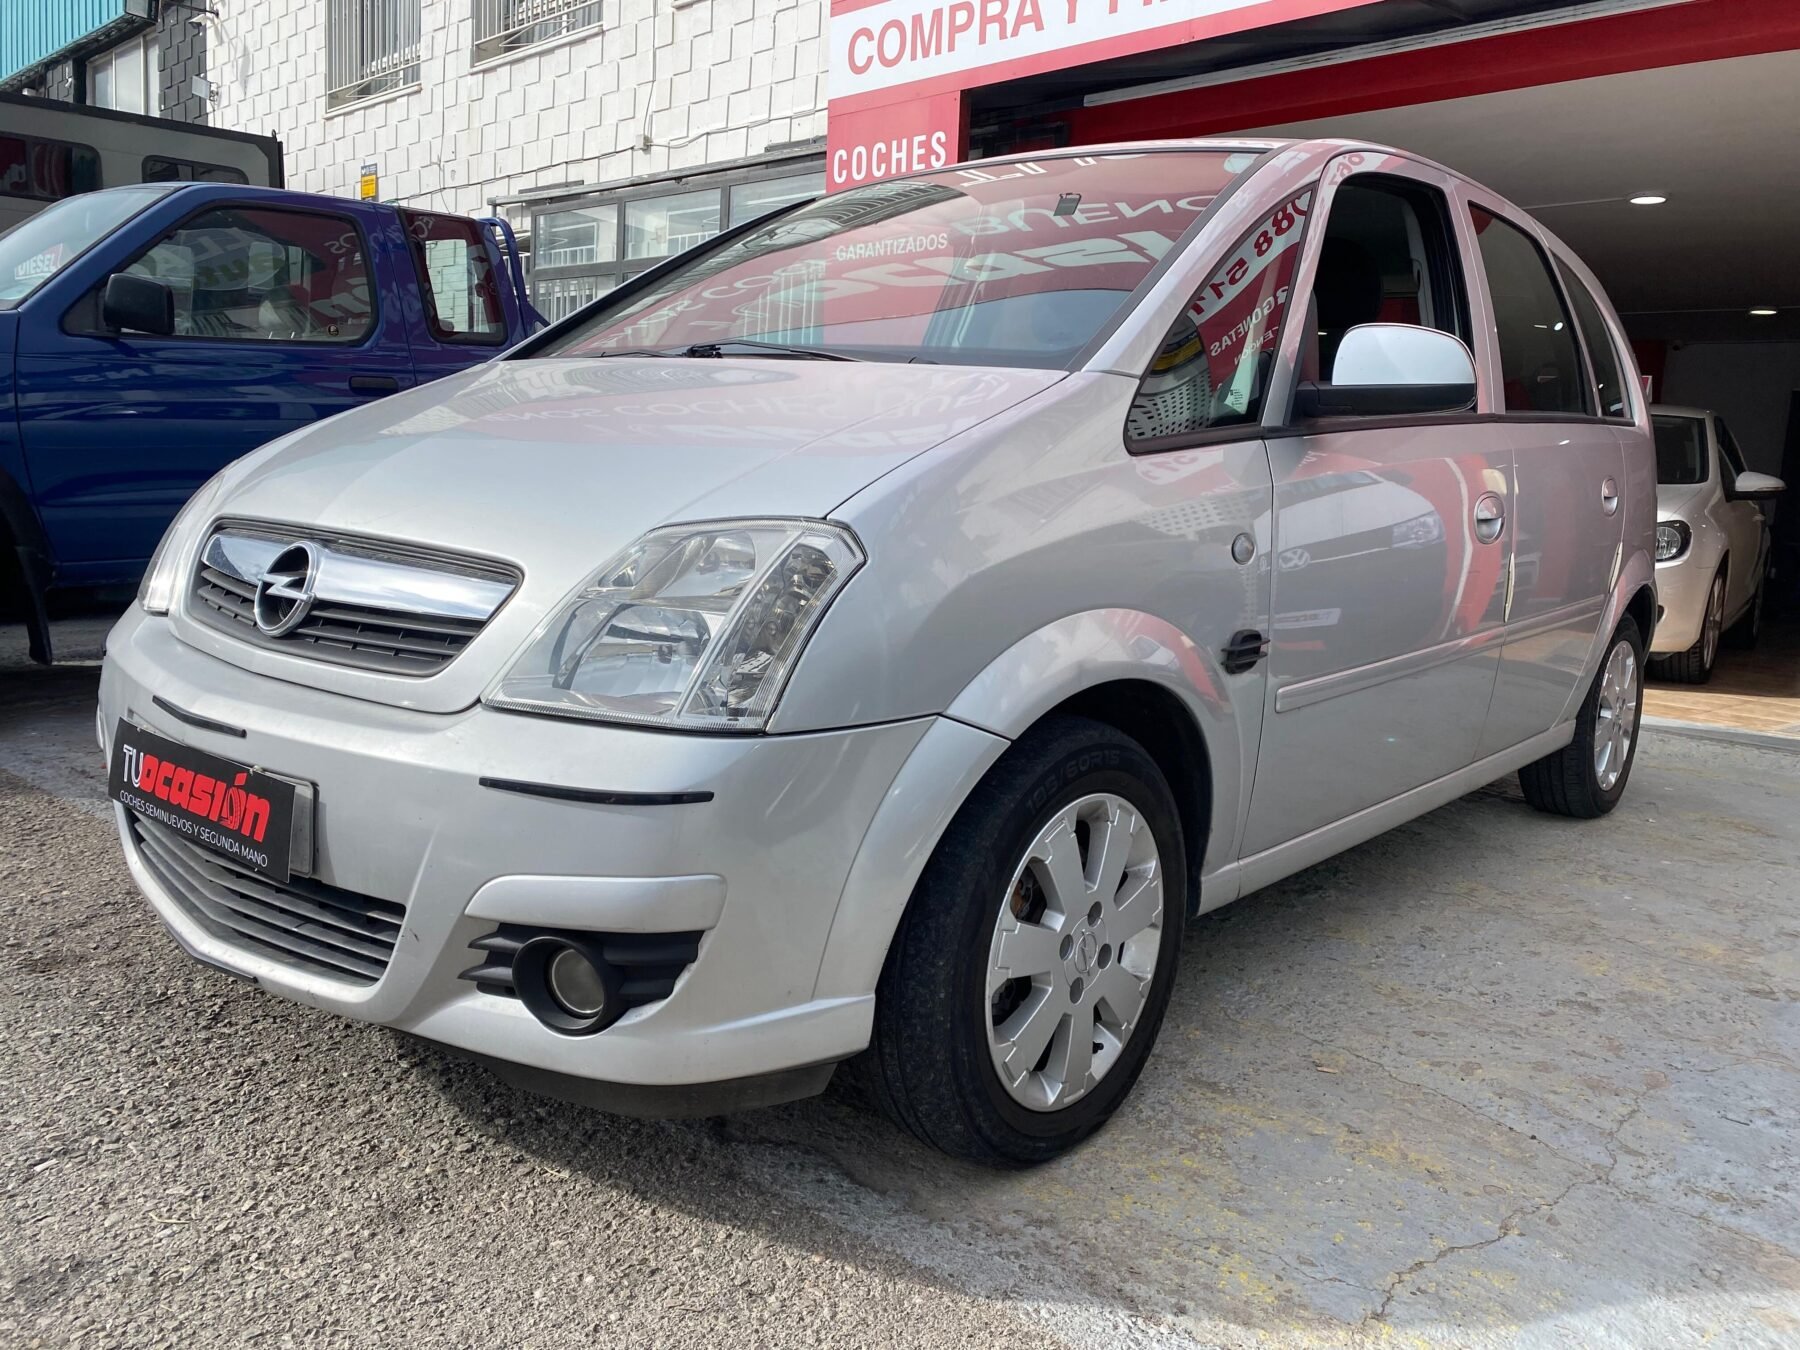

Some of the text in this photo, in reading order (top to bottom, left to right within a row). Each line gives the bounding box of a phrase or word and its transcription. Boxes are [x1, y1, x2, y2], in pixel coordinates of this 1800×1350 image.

[848, 0, 1045, 76] COMPRA
[833, 131, 947, 184] COCHES
[18, 254, 56, 275] DIESEL
[835, 232, 949, 261] GARANTIZADOS
[119, 789, 268, 868] COCHES SEMINUEVOS Y SEGUNDA MANO
